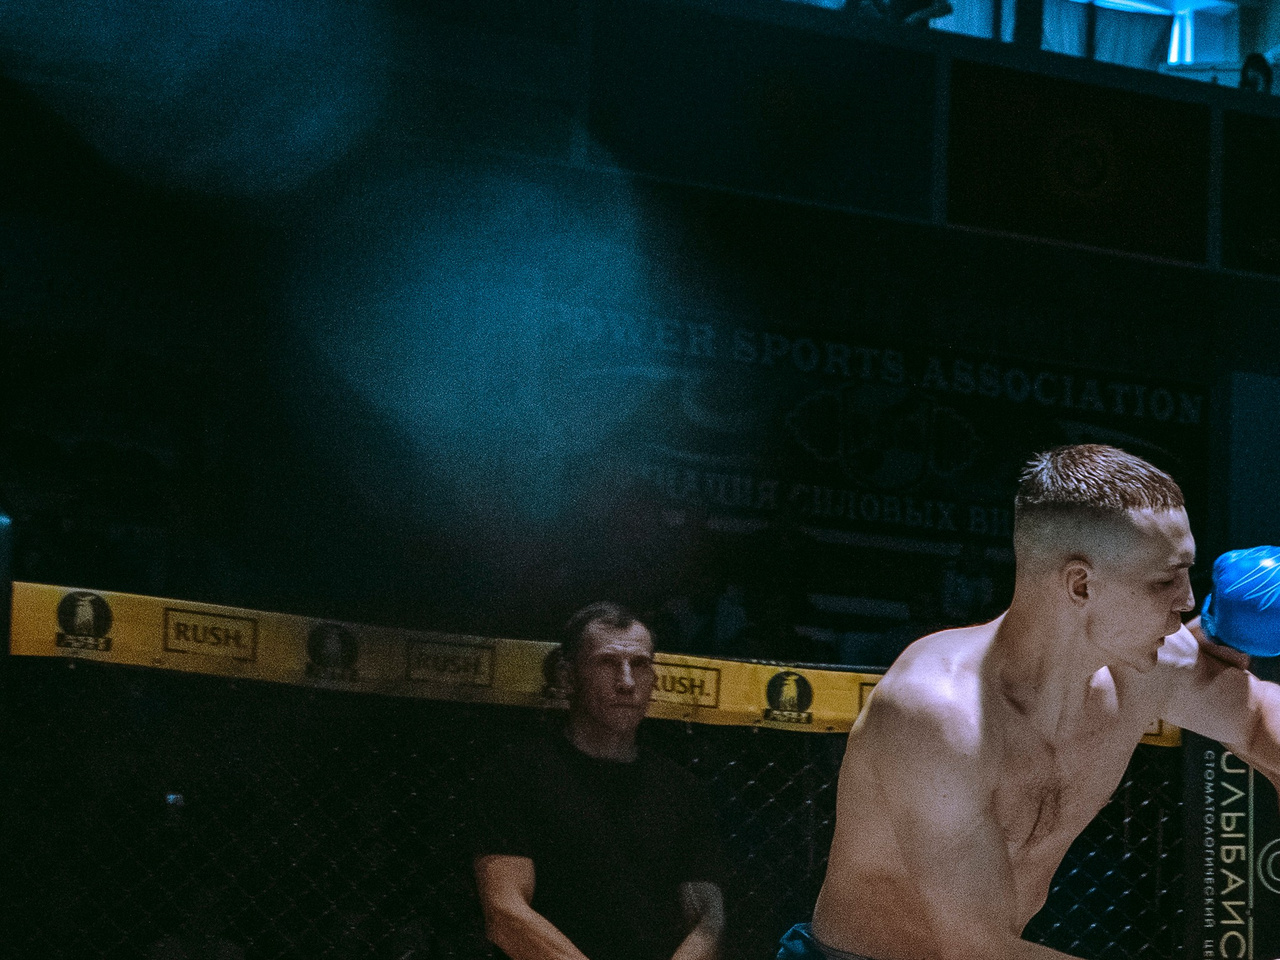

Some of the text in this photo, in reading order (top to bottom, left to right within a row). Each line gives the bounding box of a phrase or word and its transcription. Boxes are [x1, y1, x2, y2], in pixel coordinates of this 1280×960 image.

[732, 327, 907, 385] SPORTS
[922, 356, 1205, 427] ASSOCIATION
[173, 623, 245, 648] RUSH.
[1202, 750, 1216, 928] СТОМАТОЛОГИЧЕСКИЙ
[1219, 751, 1250, 959] УЛЫБАЙС
